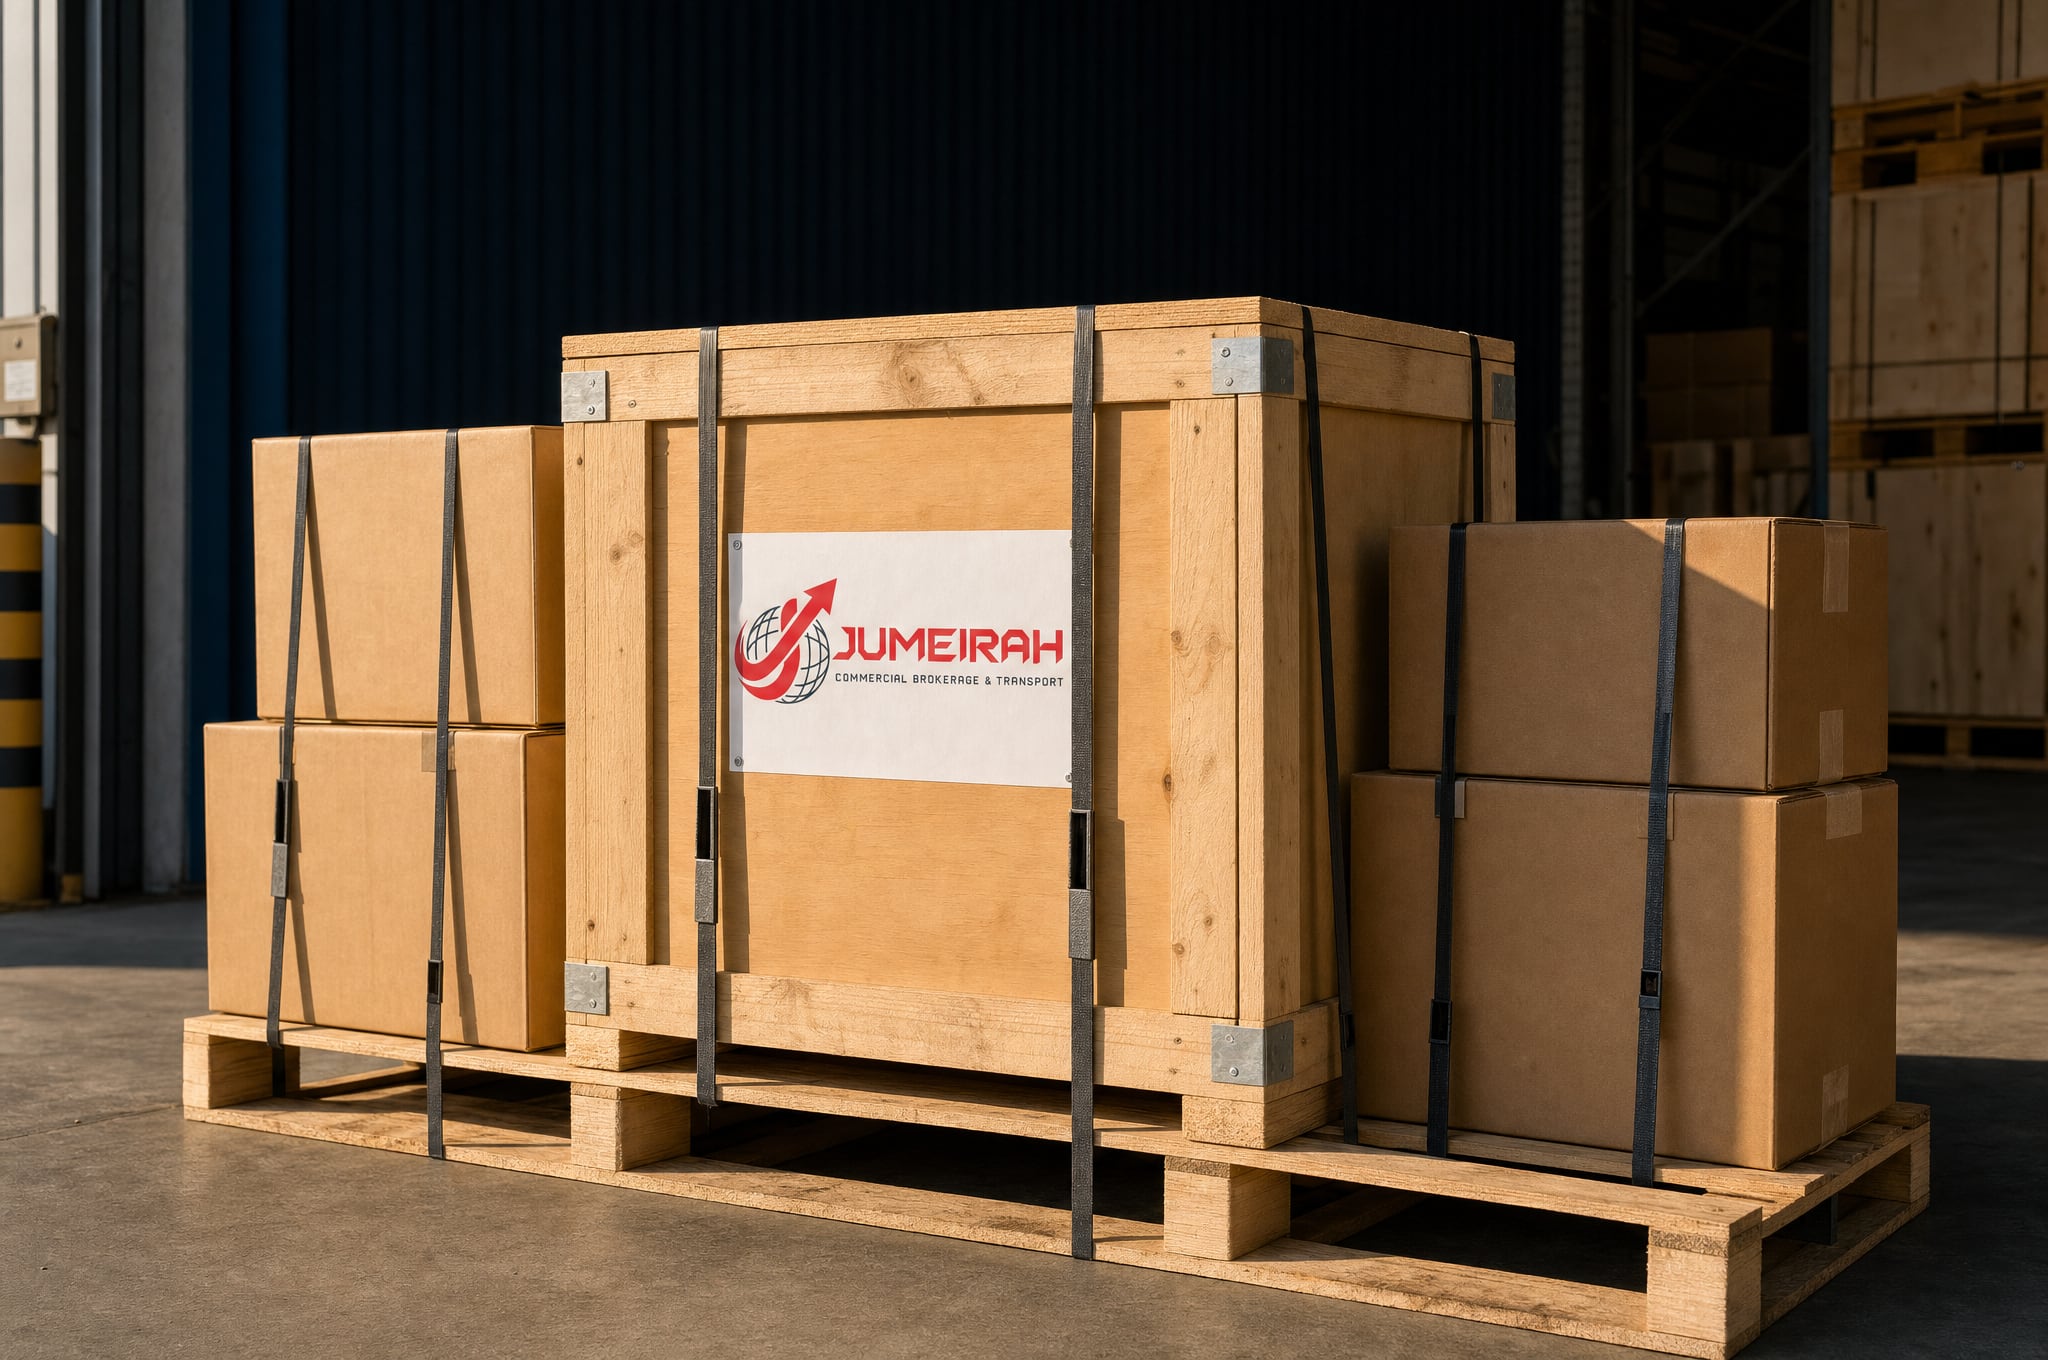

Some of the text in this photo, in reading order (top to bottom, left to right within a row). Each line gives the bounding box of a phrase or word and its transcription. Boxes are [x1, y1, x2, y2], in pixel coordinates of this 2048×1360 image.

[832, 626, 1064, 664] JUMEIRAH
[835, 672, 1064, 687] COMMERCIAL BROKERAGE & TRANSPORT
